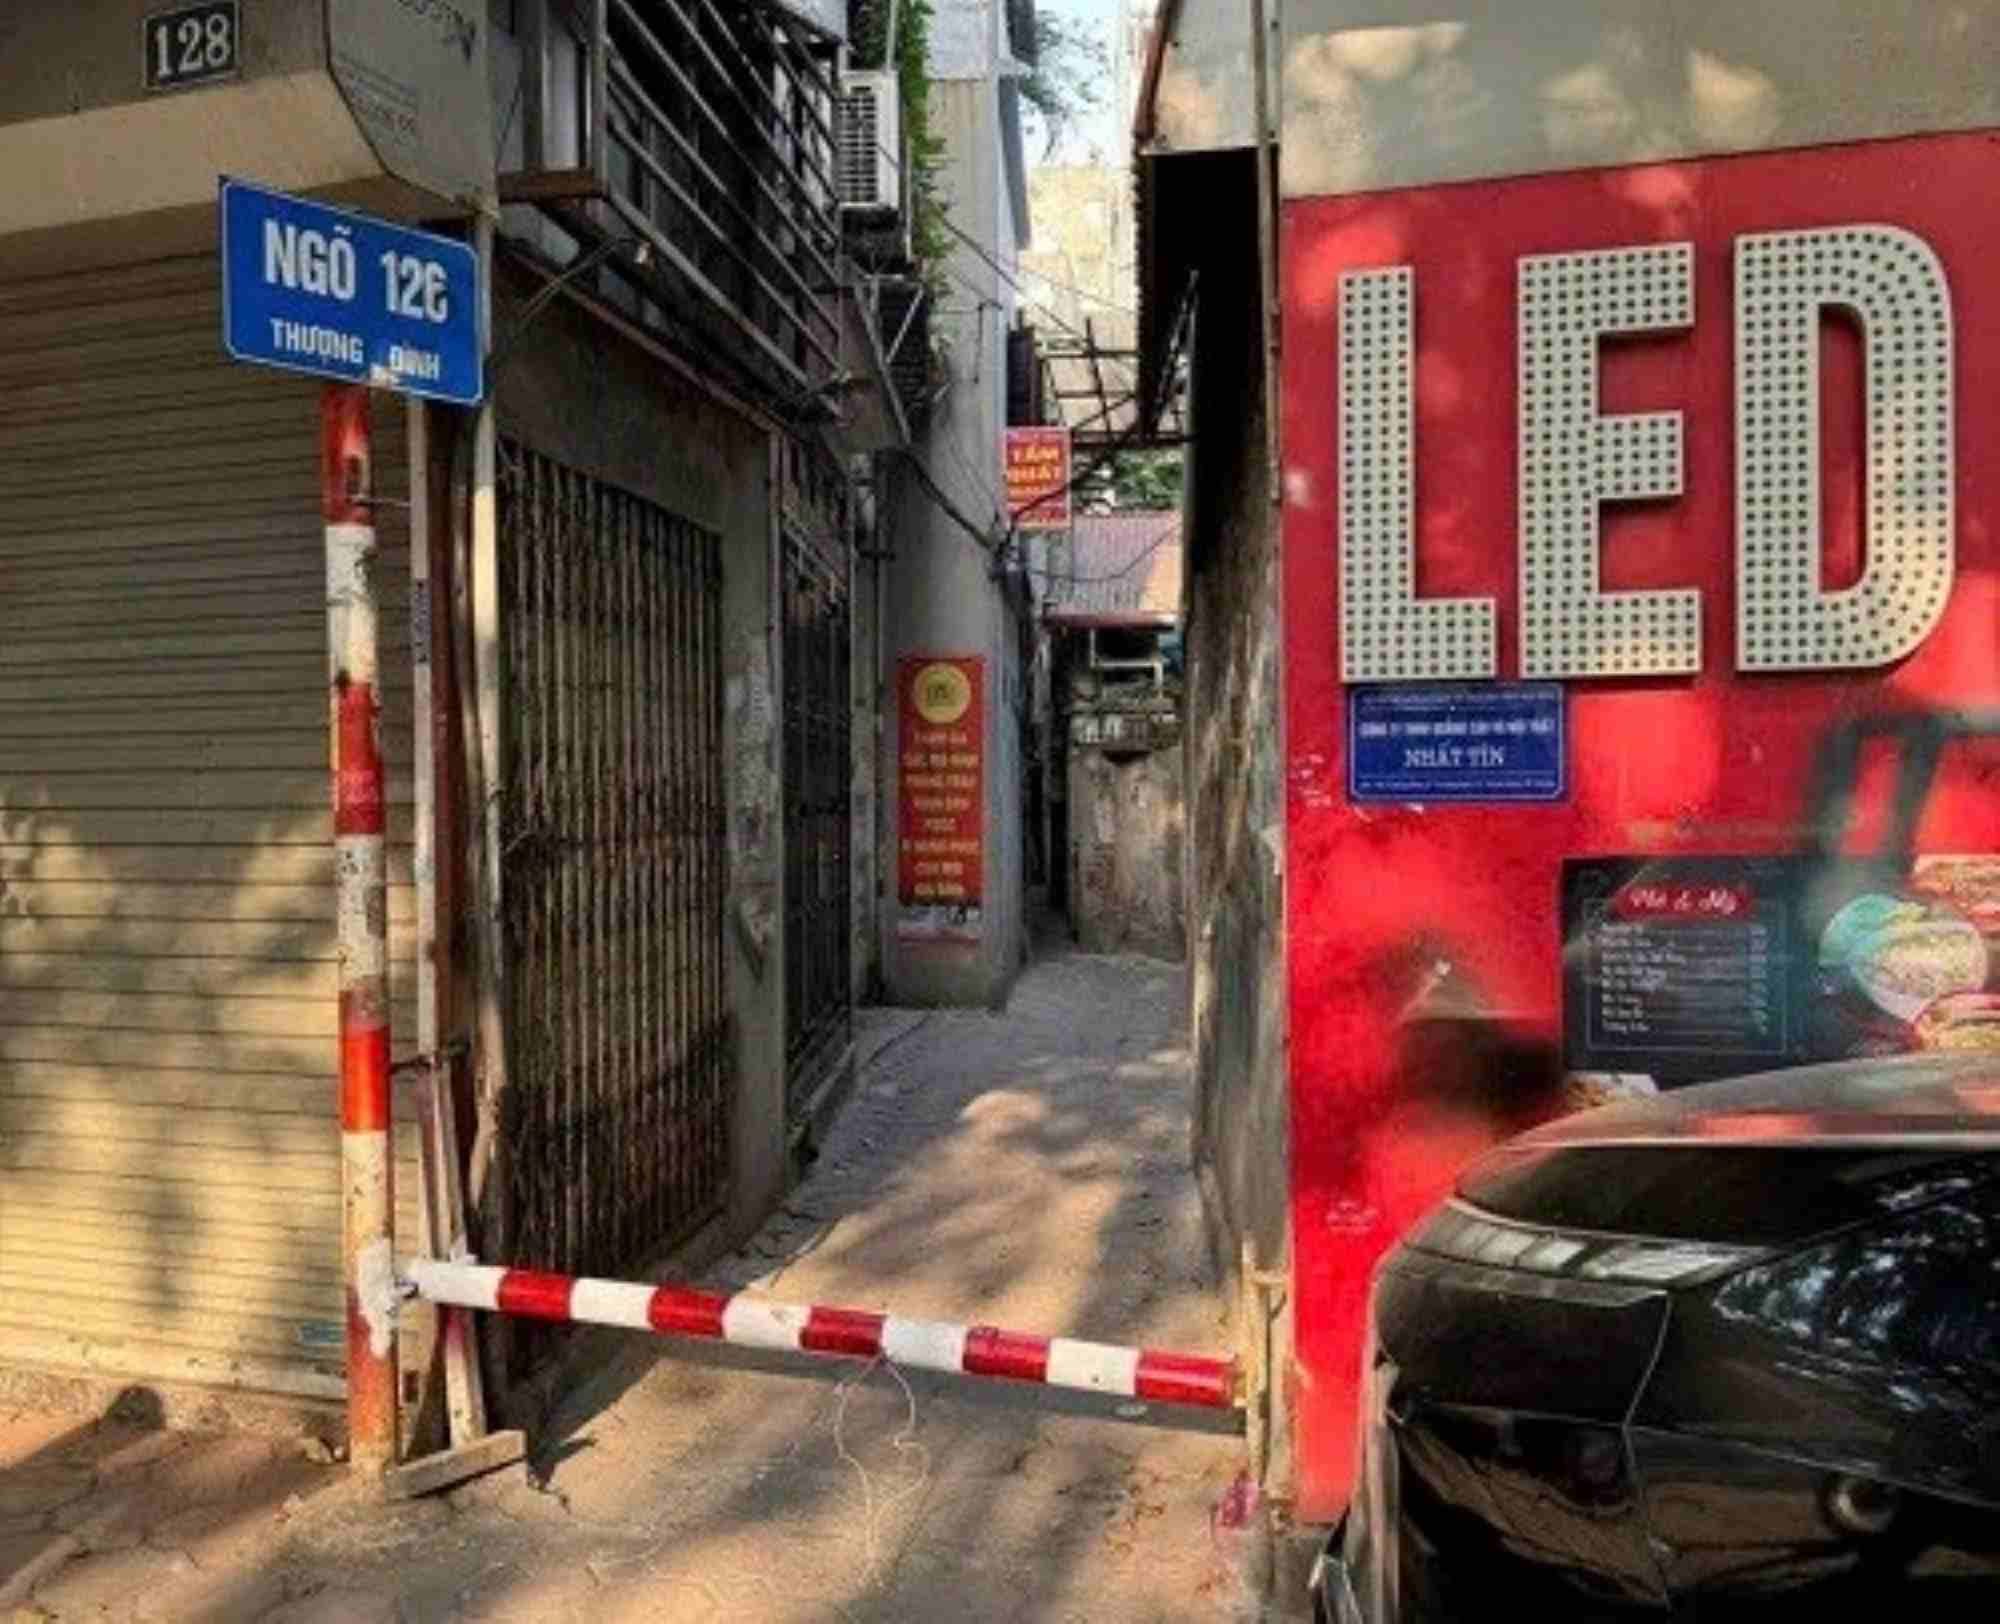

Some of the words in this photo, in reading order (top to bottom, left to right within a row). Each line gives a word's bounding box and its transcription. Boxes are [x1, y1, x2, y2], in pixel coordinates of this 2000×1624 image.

[158, 13, 232, 77] 128
[264, 219, 356, 300] NGÕ
[1338, 223, 1955, 681] LED
